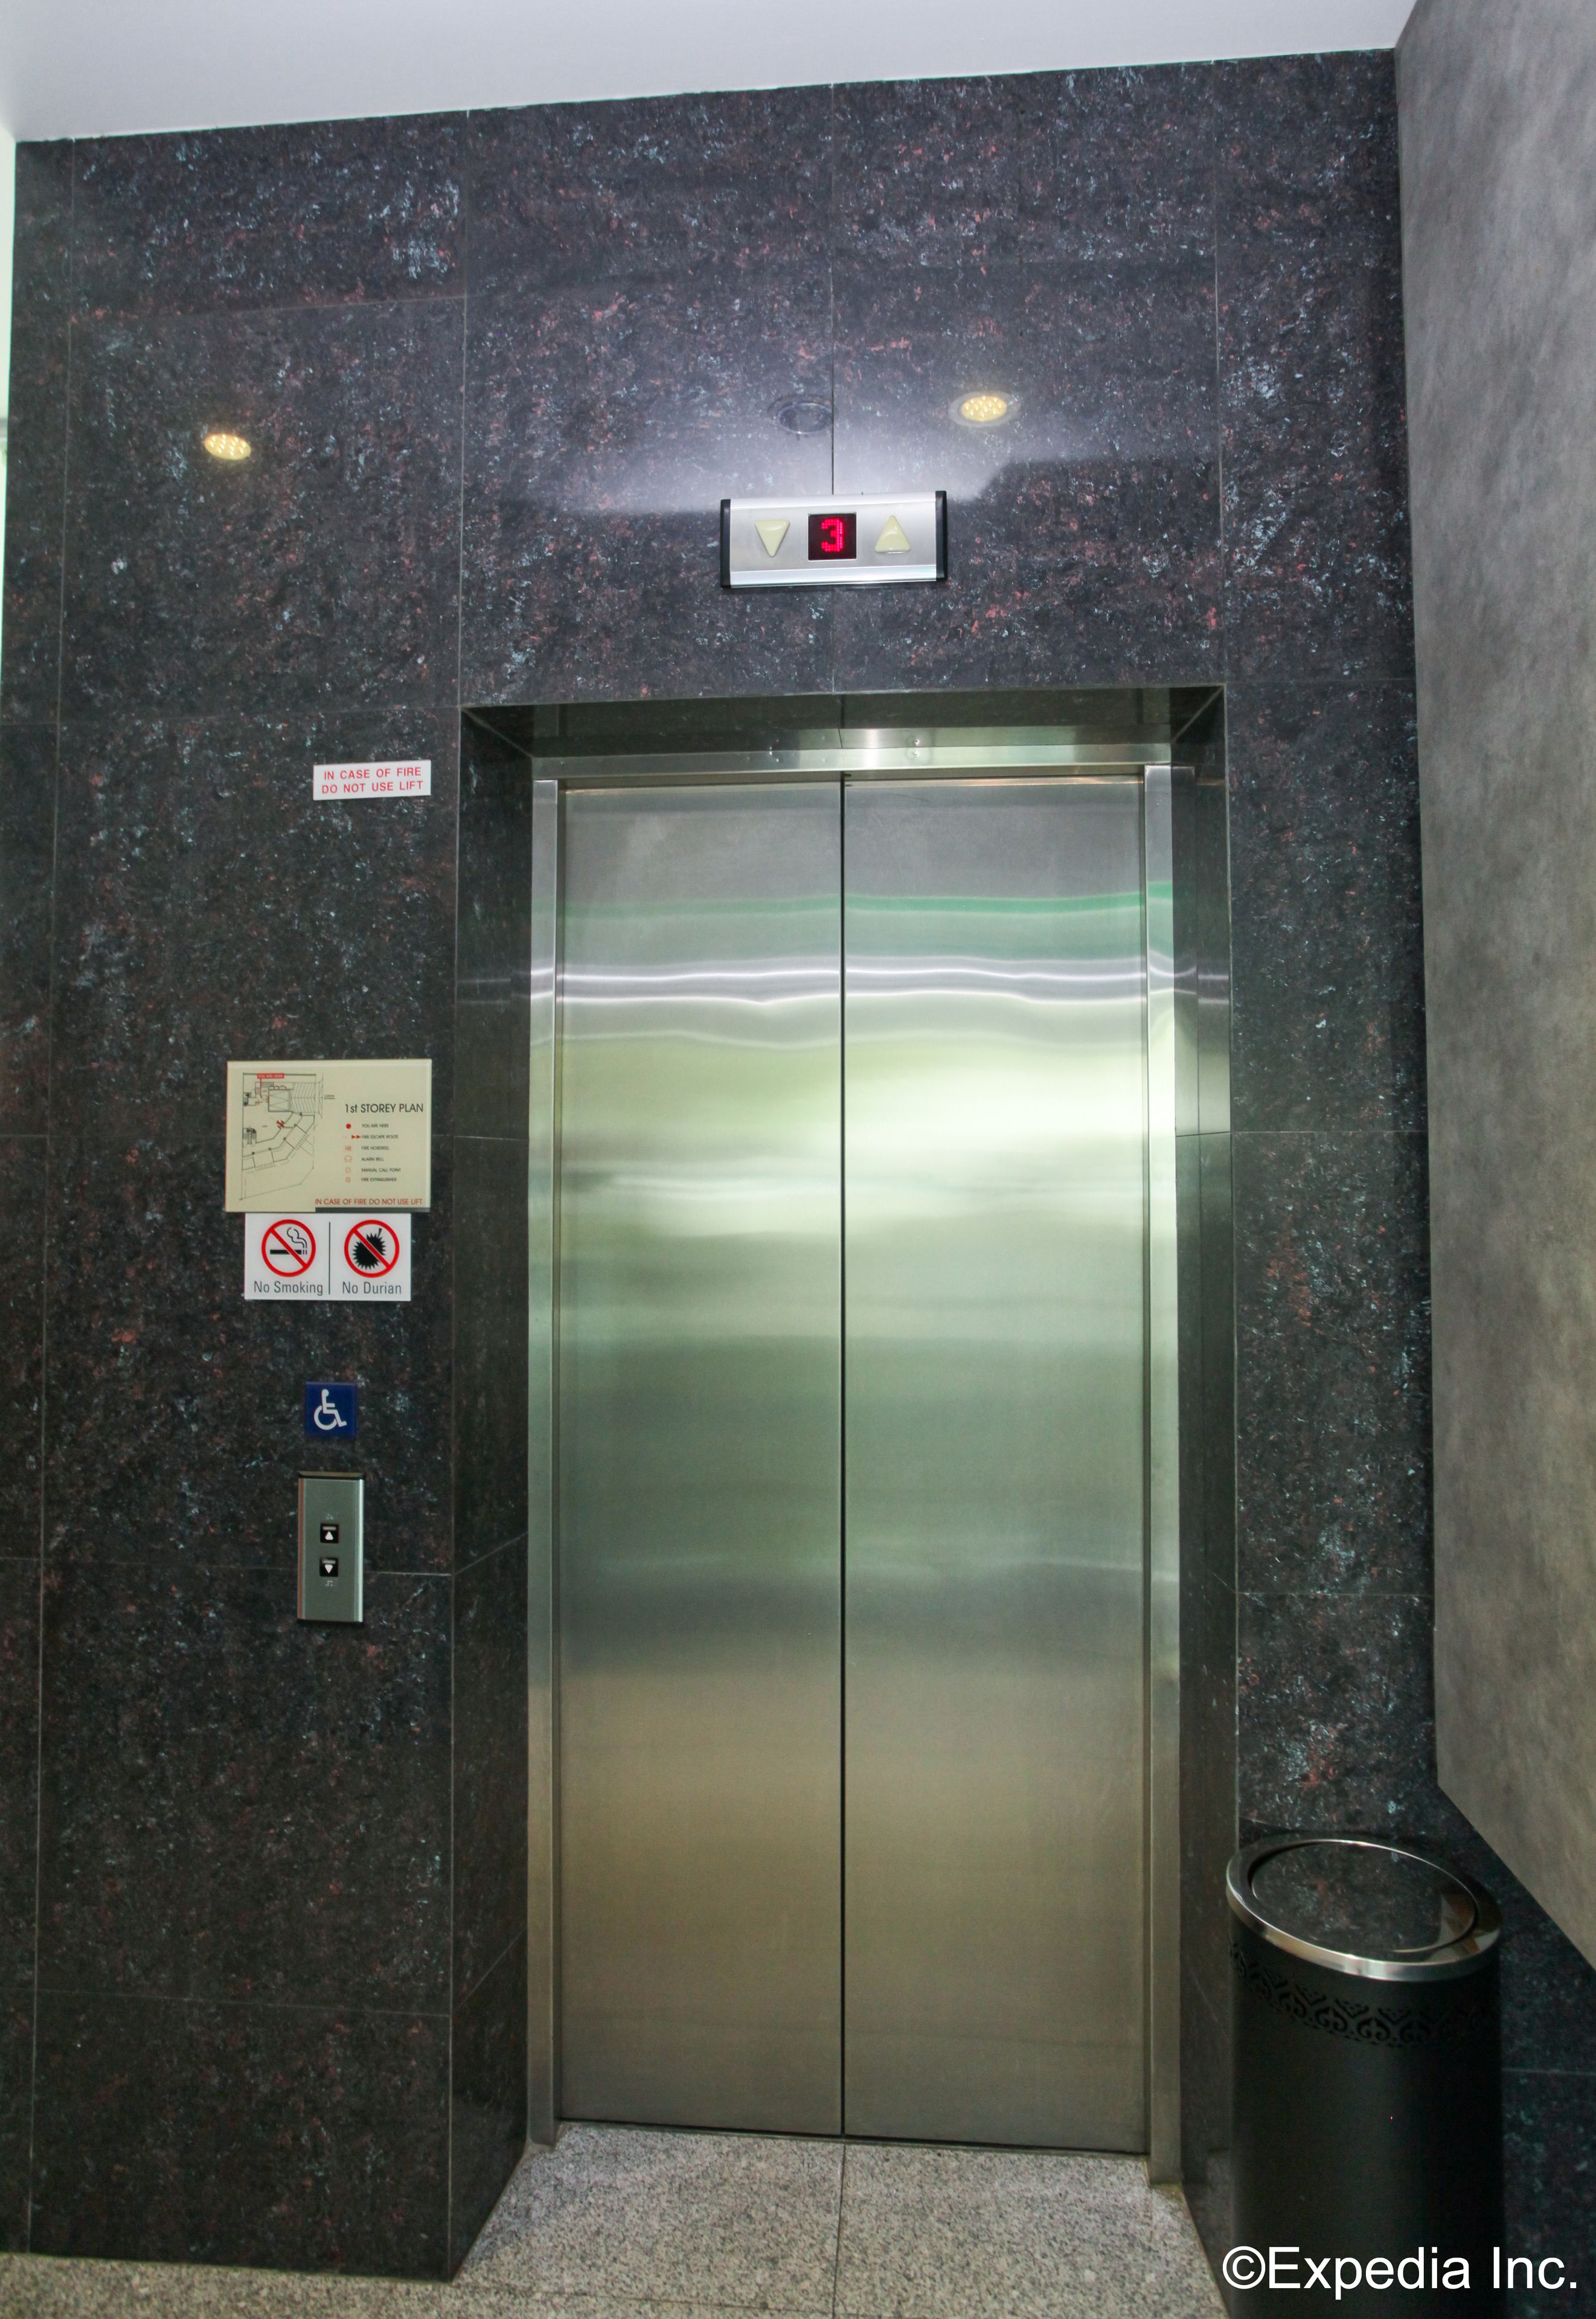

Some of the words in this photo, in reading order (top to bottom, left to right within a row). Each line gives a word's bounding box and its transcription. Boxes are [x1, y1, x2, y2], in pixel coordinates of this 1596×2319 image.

[821, 518, 844, 553] 3
[324, 771, 335, 780] IN
[340, 769, 370, 780] CASE
[376, 768, 391, 778] OF
[397, 767, 421, 777] FIRE
[322, 784, 338, 794] DO
[344, 783, 366, 793] NOT
[371, 782, 394, 792] USE
[399, 781, 423, 791] LIFT
[345, 1103, 357, 1113] 1st
[361, 1103, 396, 1113] STOREY
[399, 1103, 423, 1112] PLAN
[254, 1281, 270, 1294] No
[274, 1281, 323, 1296] Smoking
[342, 1281, 358, 1294] No
[364, 1281, 402, 1294] Durian
